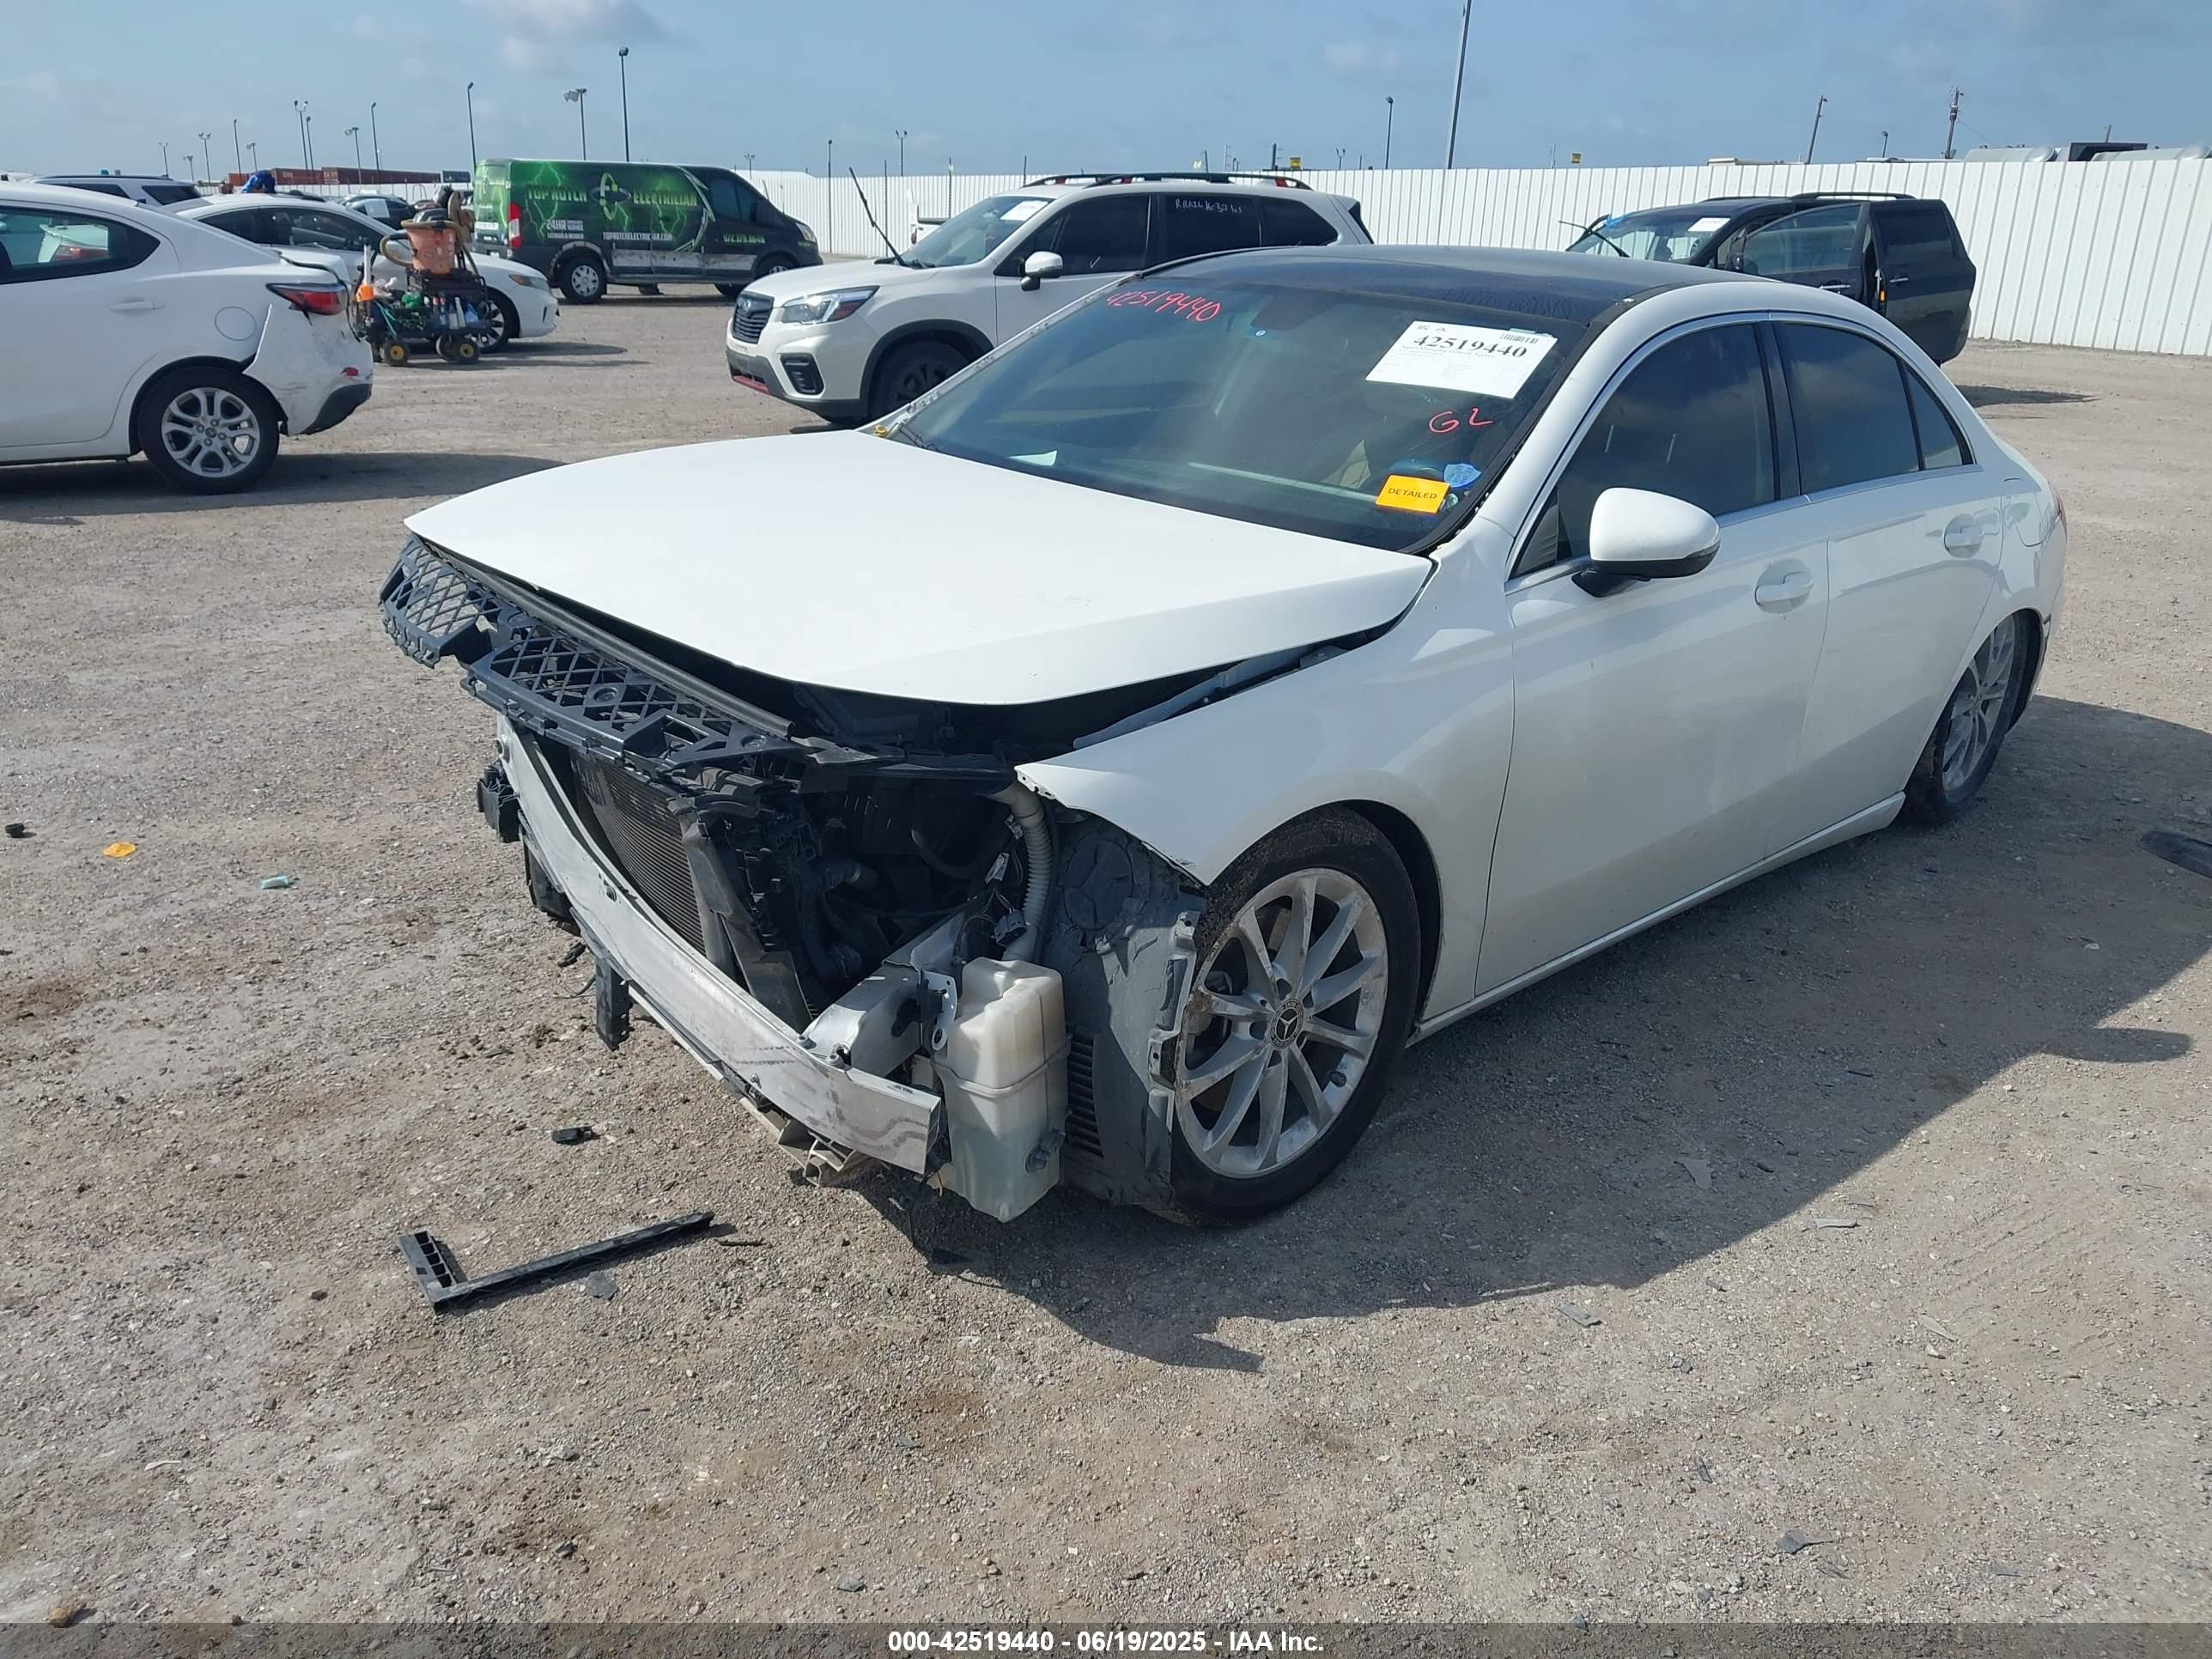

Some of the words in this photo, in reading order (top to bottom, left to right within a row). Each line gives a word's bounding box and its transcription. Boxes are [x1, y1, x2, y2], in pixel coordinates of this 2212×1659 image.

[527, 188, 549, 200] TOP
[550, 189, 587, 202] NOTCH
[633, 190, 697, 206] ELECTRICIAN
[546, 219, 567, 230] 24HR
[1106, 290, 1221, 322] 42519440
[1413, 335, 1528, 358] 42519440
[1388, 487, 1437, 500] DETAILED
